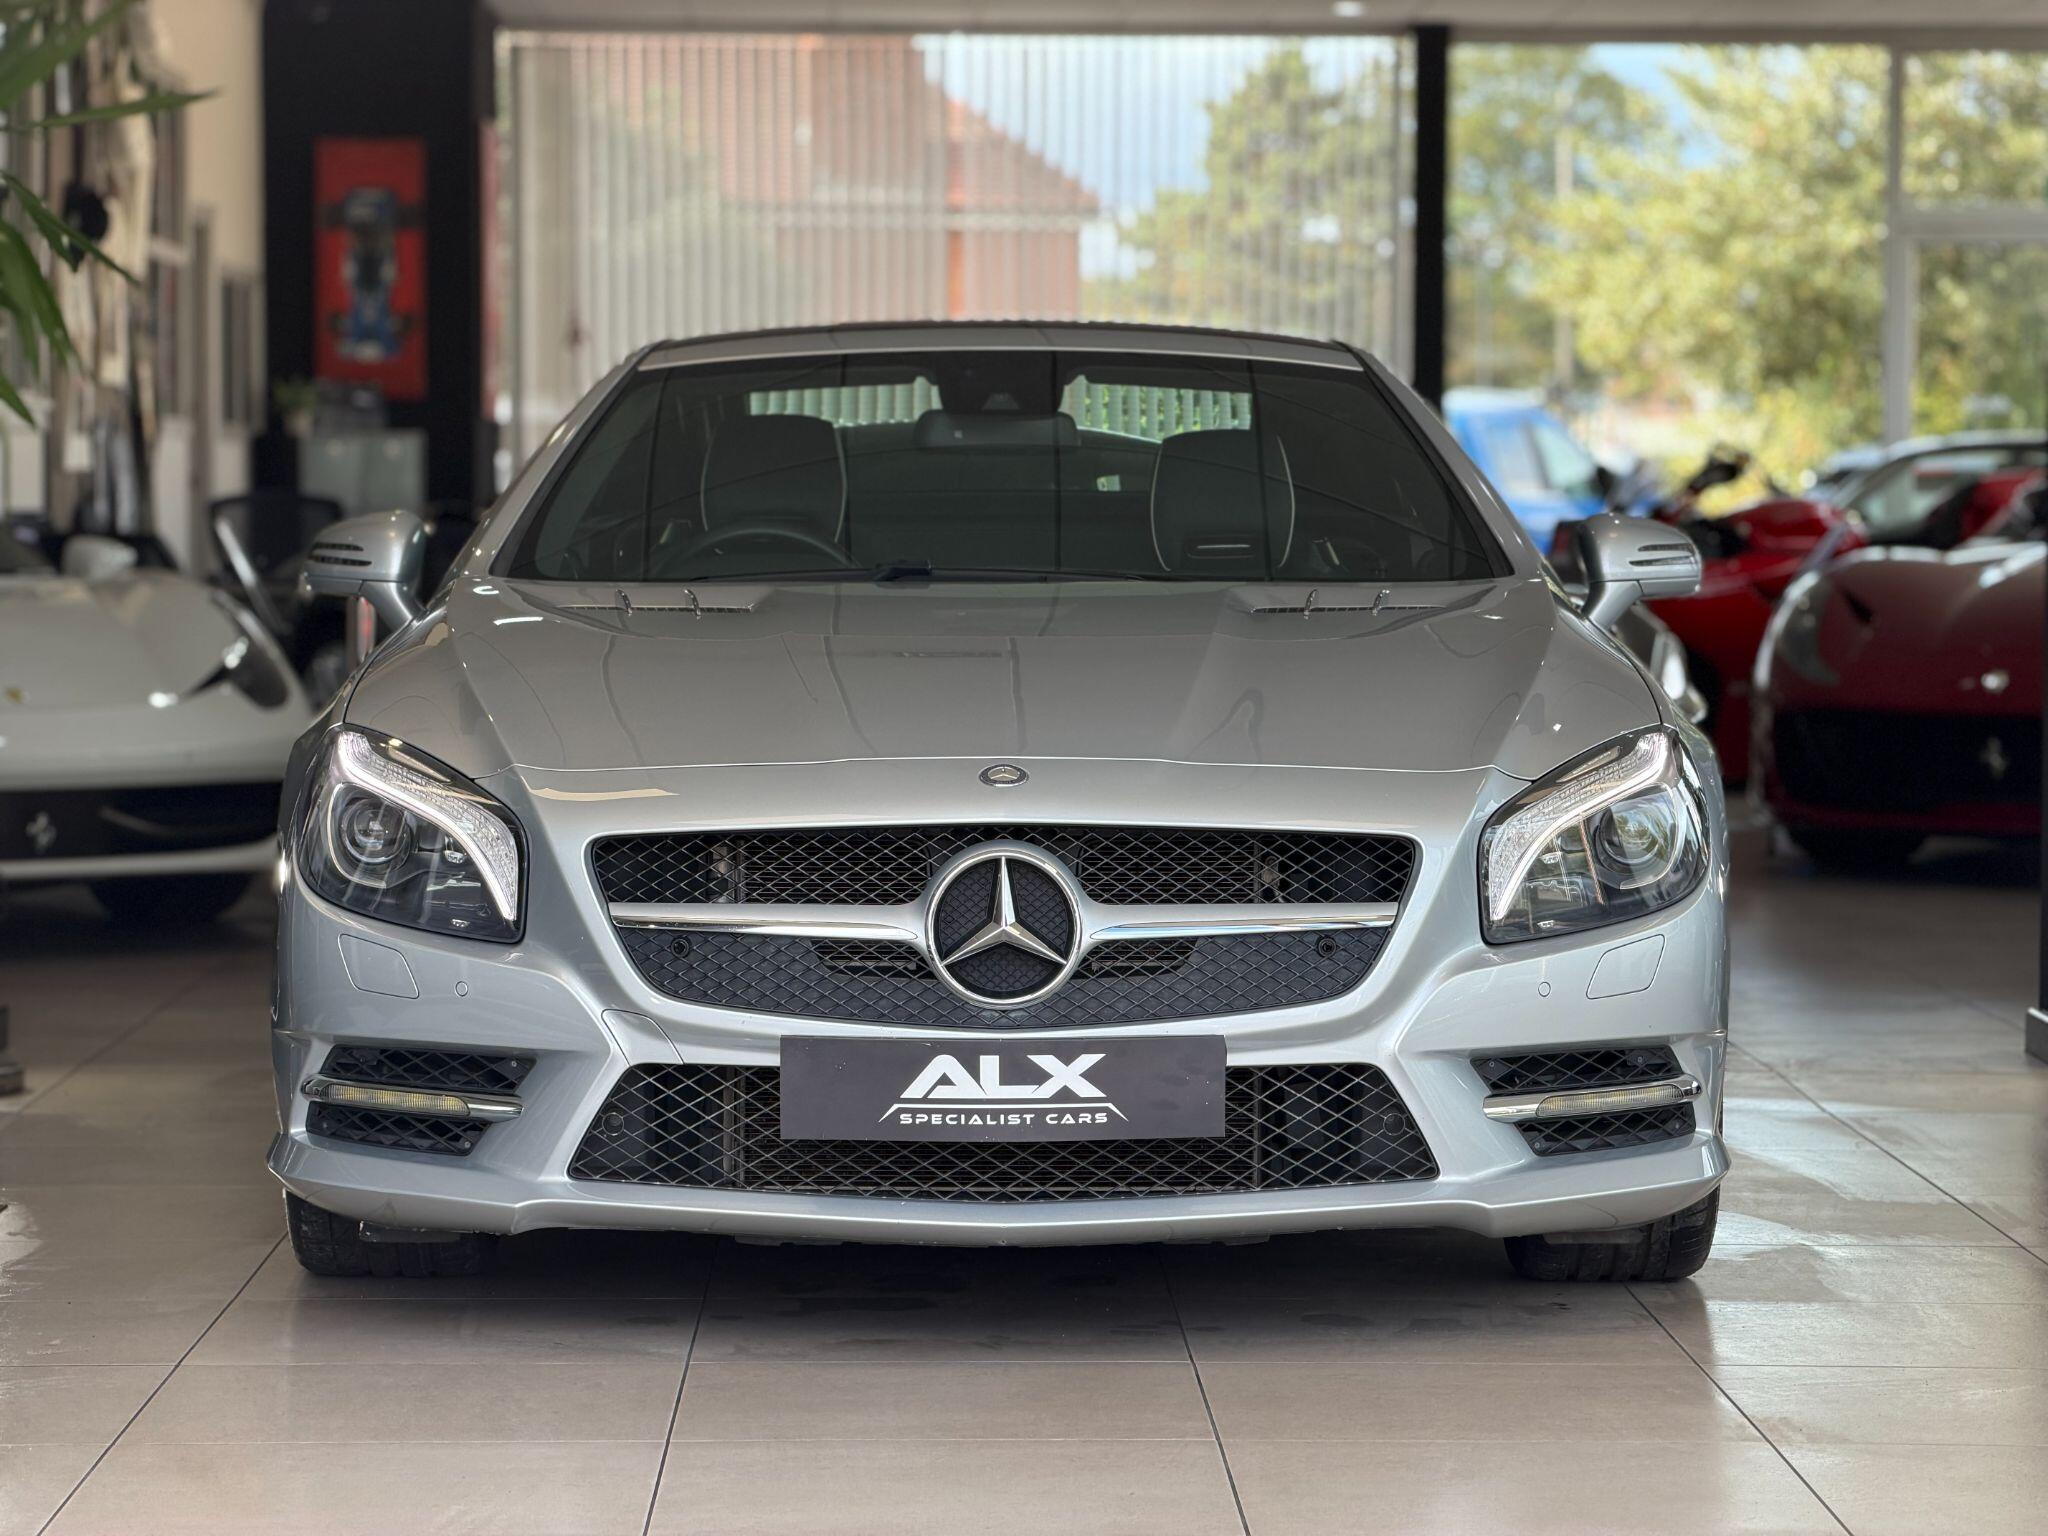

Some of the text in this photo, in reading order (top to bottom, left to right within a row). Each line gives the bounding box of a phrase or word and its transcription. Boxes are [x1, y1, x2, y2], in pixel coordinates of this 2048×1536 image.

[900, 1054, 1107, 1099] ALX
[899, 1112, 1108, 1126] SPECIALIST CARS
